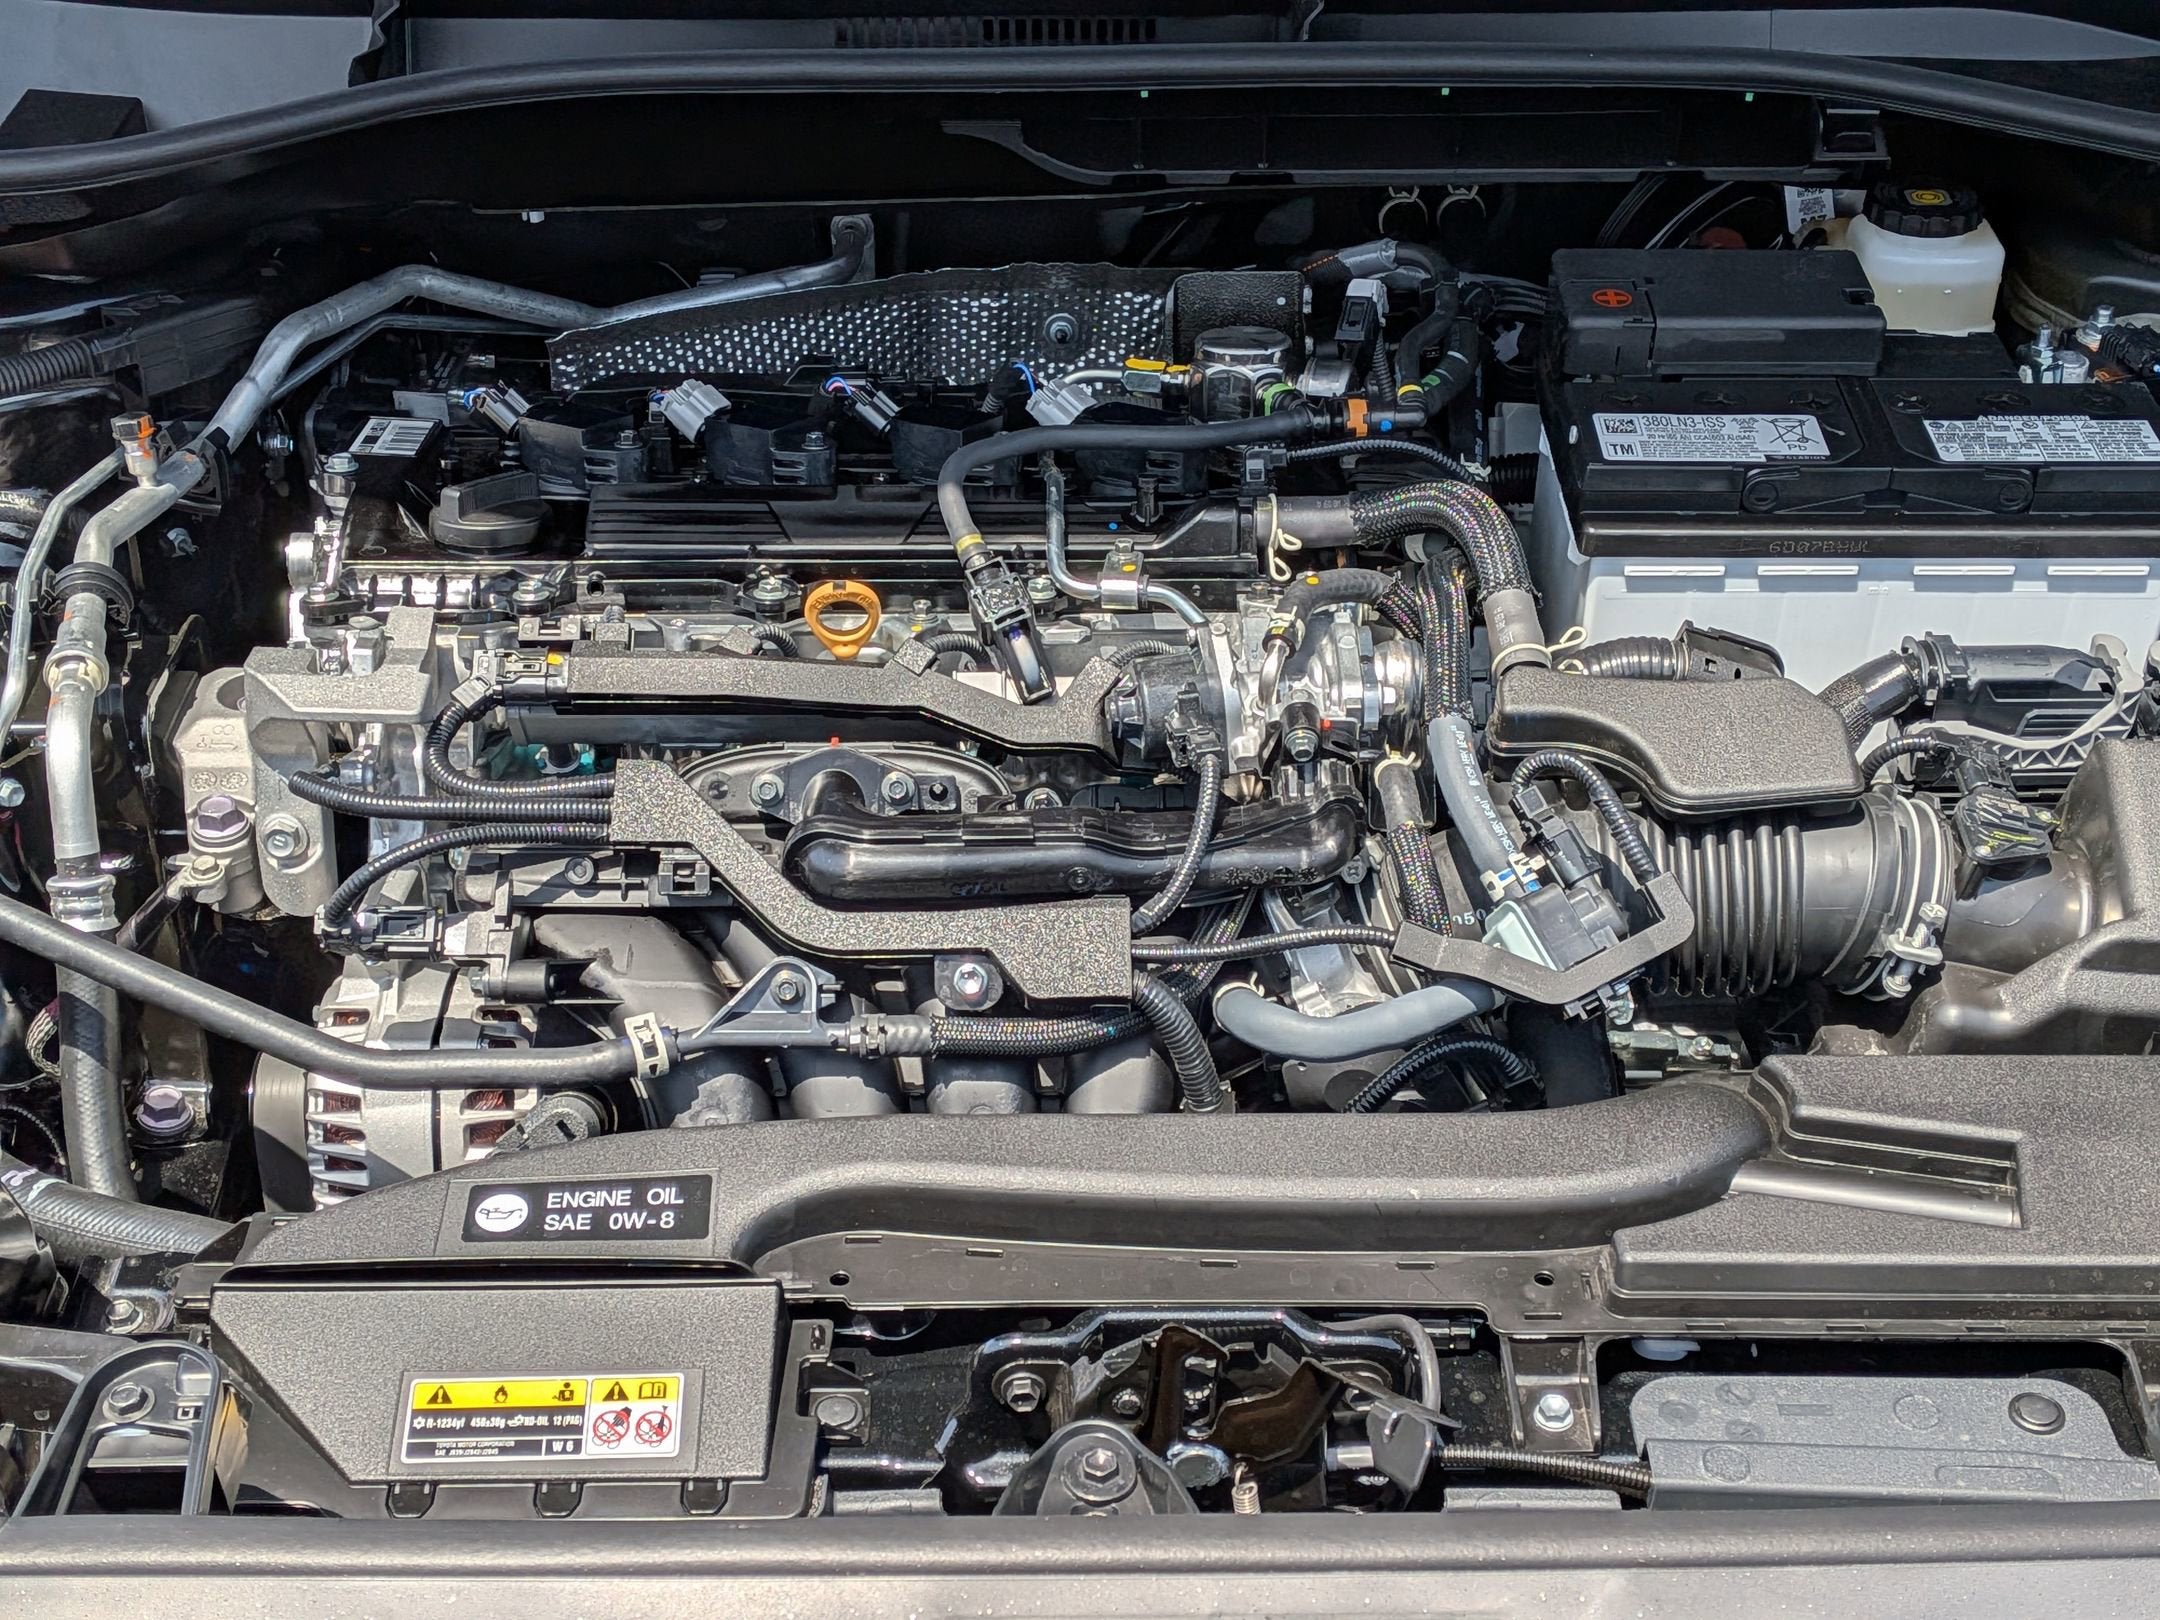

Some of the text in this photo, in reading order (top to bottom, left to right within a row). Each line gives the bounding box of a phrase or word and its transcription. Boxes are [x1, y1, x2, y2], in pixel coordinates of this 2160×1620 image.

[1642, 415, 1727, 428] 380LN3-ISS
[1609, 443, 1634, 455] TM
[1787, 443, 1808, 451] Pb
[546, 1187, 684, 1208] ENGINE OIL
[543, 1211, 675, 1231] SAE 0W-8
[552, 1440, 574, 1452] W 6
